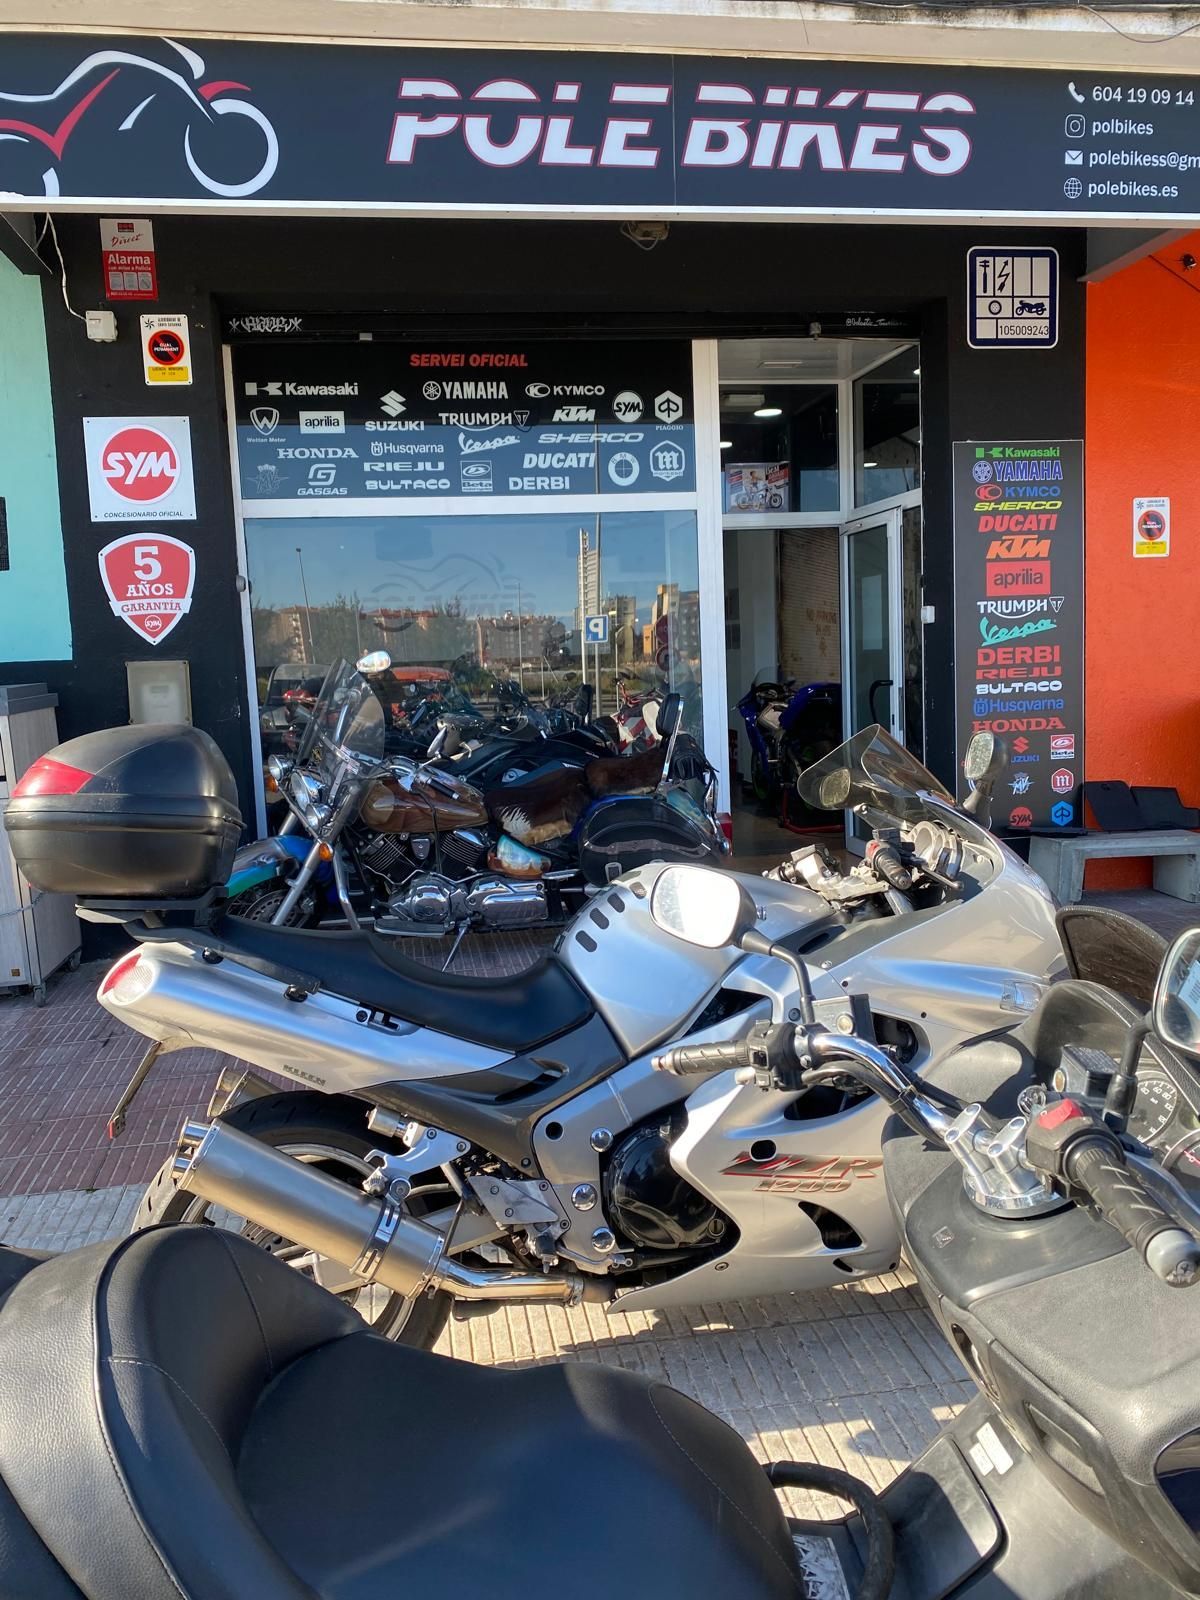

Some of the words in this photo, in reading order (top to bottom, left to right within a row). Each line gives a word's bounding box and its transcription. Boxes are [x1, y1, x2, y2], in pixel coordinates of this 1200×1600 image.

[1092, 86, 1122, 102] 604
[1127, 88, 1147, 103] 19
[1151, 89, 1171, 104] 09
[1175, 90, 1194, 105] 14
[386, 78, 671, 166] POLE
[681, 82, 975, 176] BIKES
[1092, 119, 1154, 136] polbikes
[1088, 181, 1178, 197] polebikes.es
[109, 253, 151, 264] Alarma
[1000, 325, 1049, 336] 105009243
[410, 353, 464, 367] SERVEI
[469, 353, 528, 367] OFICIAL
[285, 382, 359, 396] Kawasaki
[442, 381, 508, 399] YAMAHA
[553, 385, 605, 396] KYMCO
[552, 405, 596, 422] KTM
[614, 402, 643, 414] SYM
[304, 415, 340, 429] aprilia
[365, 420, 424, 431] SUZUKI
[438, 412, 513, 428] TRIUMPH
[458, 431, 520, 455] Vespa
[538, 432, 644, 444] SHERCO
[277, 447, 359, 459] HONDA
[384, 442, 444, 456] Husqvarna
[1006, 446, 1060, 458] Kawasaki
[363, 461, 444, 472] RIEJU
[523, 452, 597, 469] DUCATI
[104, 451, 177, 485] SYM
[994, 460, 1063, 481] YAMAHA
[365, 478, 450, 491] BULTACO
[509, 476, 570, 490] DERBI
[297, 487, 347, 496] GASGAS
[1005, 486, 1061, 497] KYMCO
[974, 501, 1062, 511] SHERCO
[104, 510, 157, 518] CONCESIONARIO
[158, 510, 184, 518] OFICIAL
[978, 514, 1058, 532] DUCATI
[986, 535, 1051, 559] KTM
[134, 545, 162, 581] 5
[994, 569, 1043, 588] aprilia
[126, 580, 174, 597] AÑOS
[121, 600, 182, 614] GARANTÍA
[977, 600, 1048, 616] TRIUMPH
[145, 619, 161, 628] SYM
[980, 616, 1057, 646] Vespa
[977, 645, 1060, 666] DERBI
[976, 666, 1062, 680] RIEJU
[976, 680, 1062, 695] BULTACO
[989, 697, 1064, 713] Husqvarna
[972, 716, 1065, 733] HONDA
[1010, 754, 1040, 763] UZUKI
[1010, 813, 1032, 825] SYM
[752, 1178, 851, 1192] 1200
